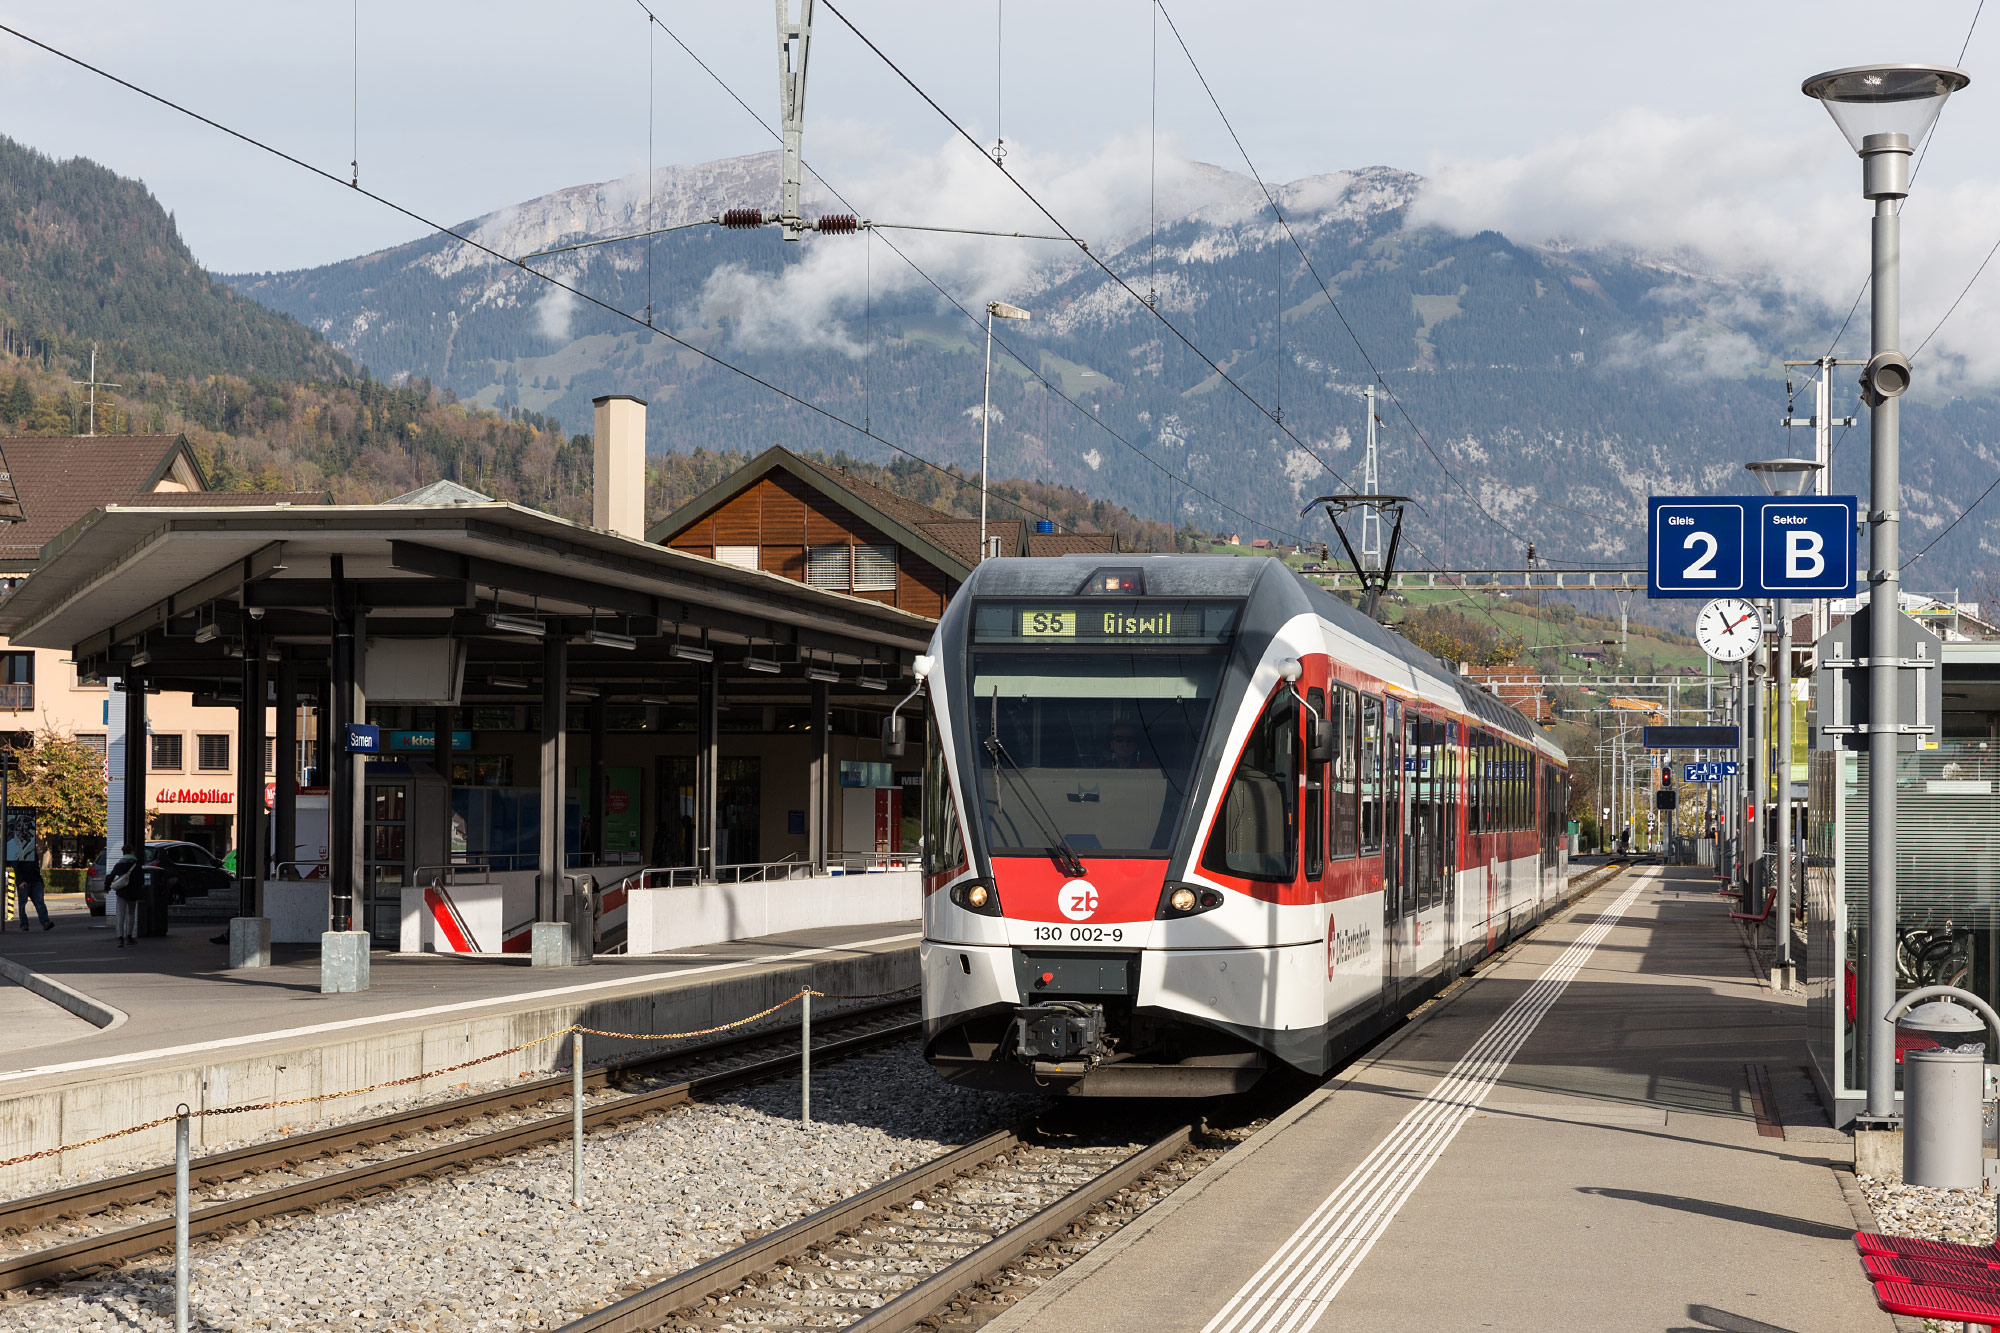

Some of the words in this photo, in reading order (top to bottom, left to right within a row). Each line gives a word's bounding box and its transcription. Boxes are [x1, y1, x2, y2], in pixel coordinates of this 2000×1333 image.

[1668, 516, 1695, 526] Gleis
[1772, 515, 1808, 525] Sektor
[1682, 531, 1718, 579] 2
[1785, 530, 1825, 579] B
[1032, 612, 1064, 633] S5
[1103, 613, 1171, 634] Giswil
[411, 735, 435, 745] kios
[156, 788, 177, 802] die
[178, 788, 235, 803] Mobiliar
[1070, 891, 1099, 912] zb
[1034, 926, 1063, 941] 130
[1070, 927, 1123, 942] 002-9
